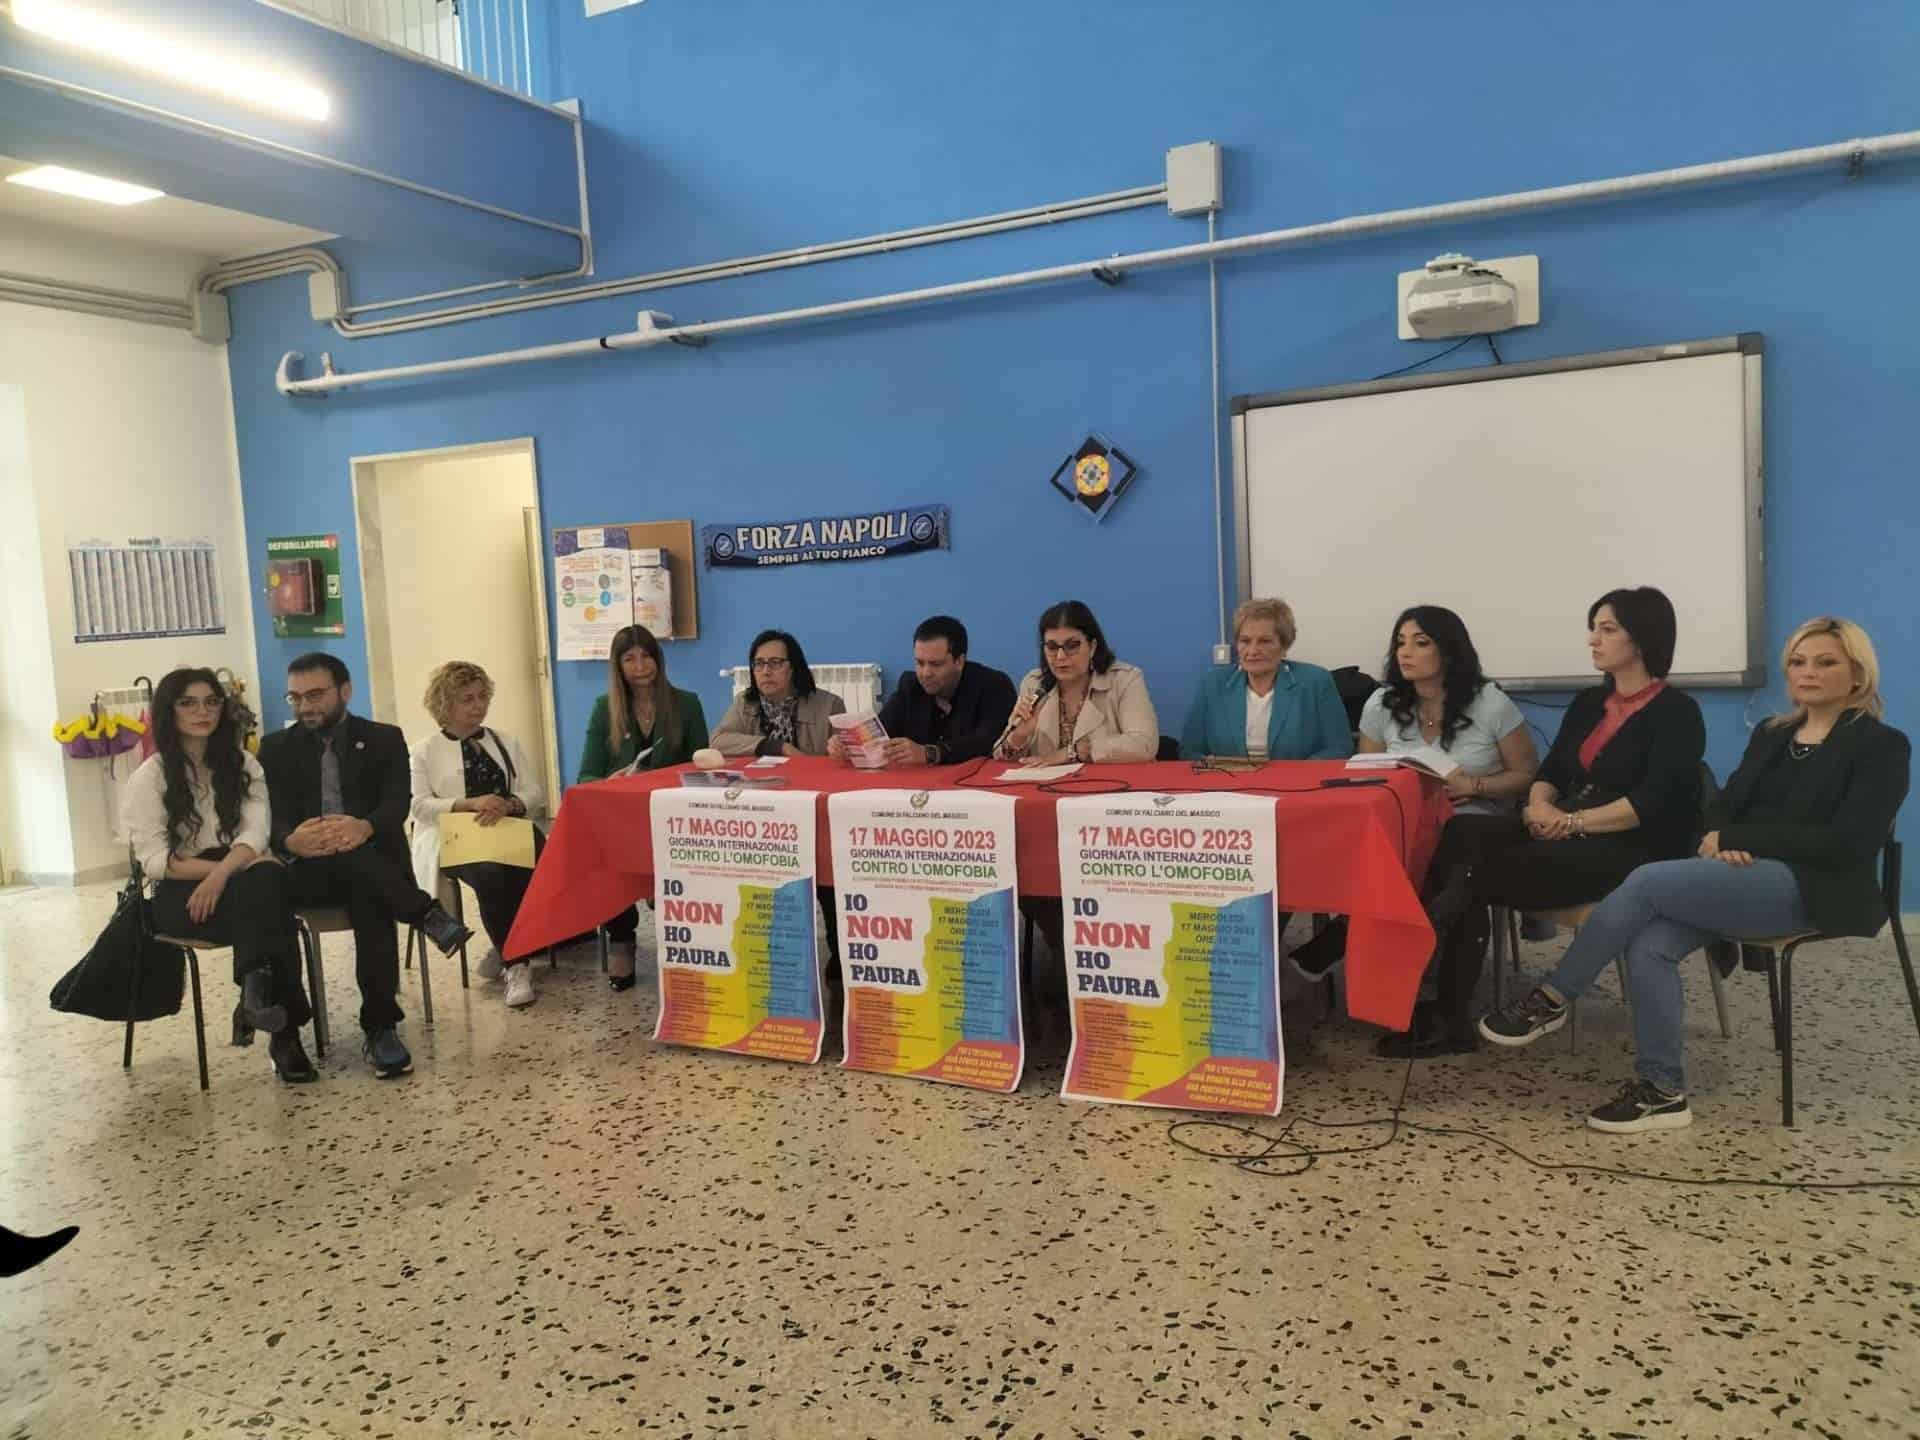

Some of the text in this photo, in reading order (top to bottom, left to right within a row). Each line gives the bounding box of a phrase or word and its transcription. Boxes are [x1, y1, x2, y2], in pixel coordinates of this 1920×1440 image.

[736, 512, 908, 550] FORZA NAPOLI
[757, 546, 887, 565] SEMPRE AL TUO FIANCO
[666, 817, 799, 841] 17 MAGGIO 2023
[849, 827, 996, 849] 17 MAGGIO 2023
[1078, 826, 1253, 850] 17 MAGGIO 2023
[668, 837, 799, 854] GIORNATA INTERNAZIONALE
[670, 848, 800, 868] CONTRO L'OMOFOBIA
[850, 848, 997, 863] GIORNATA INTERNAZIONALE
[1080, 849, 1253, 865] GIORNATA INTERNAZIONALE
[851, 861, 998, 878] CONTRO L'OMOFOBIA
[1081, 863, 1254, 882] CONTRO L'OMOFOBIA
[664, 879, 684, 896] IO
[844, 894, 868, 911] IO
[1072, 897, 1099, 916] IO
[664, 900, 723, 925] NON
[664, 926, 692, 943] HO
[847, 915, 913, 941] NON
[1074, 920, 1151, 949] NON
[666, 946, 731, 967] PAURA
[848, 943, 878, 961] HO
[1076, 951, 1111, 969] HO
[850, 964, 921, 986] PAURA
[1077, 973, 1160, 999] PAURA
